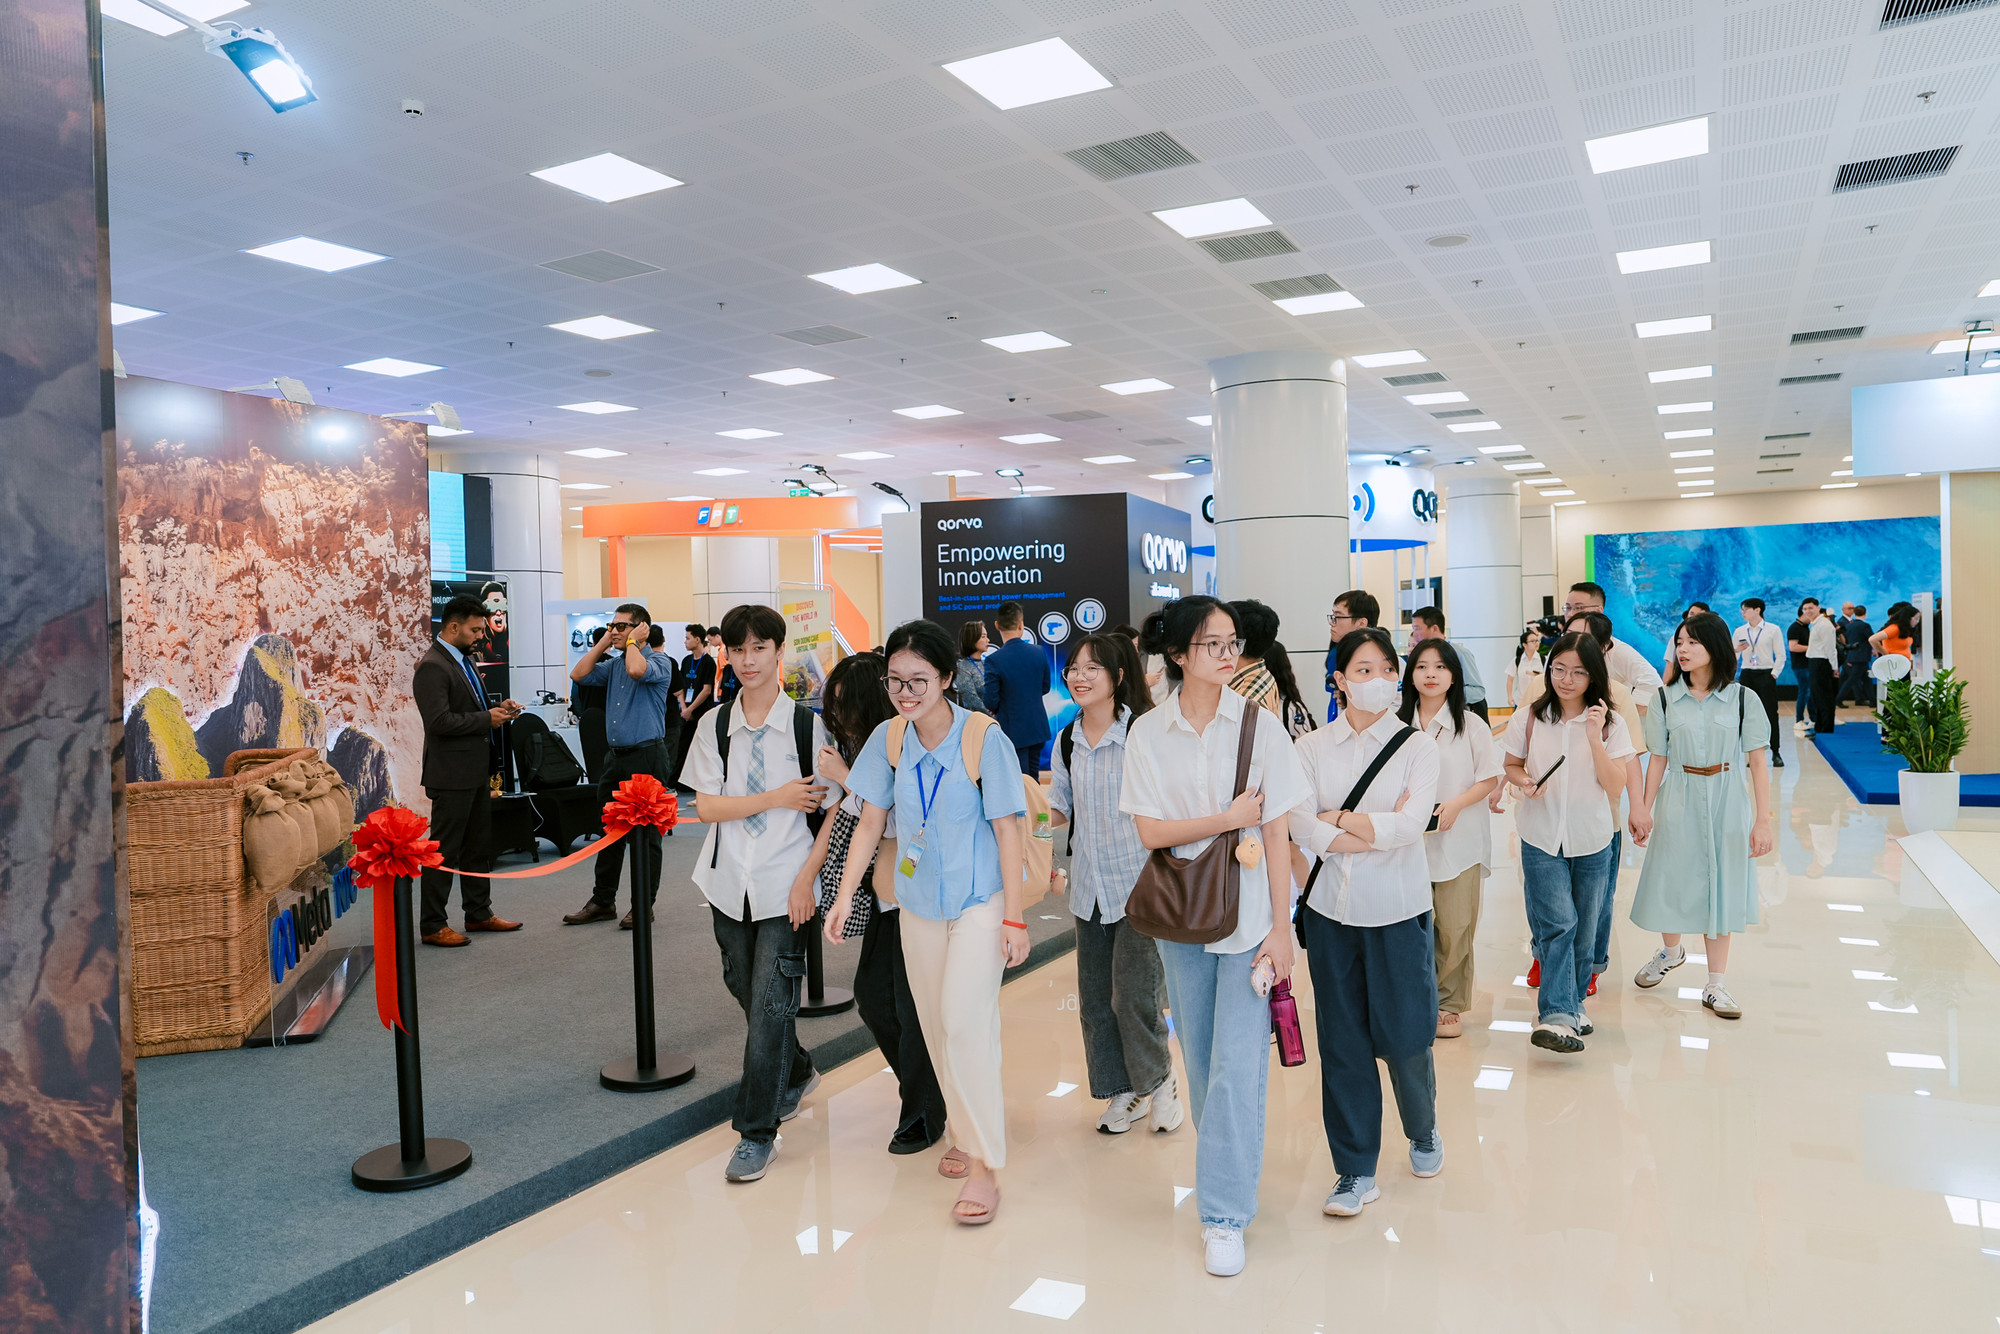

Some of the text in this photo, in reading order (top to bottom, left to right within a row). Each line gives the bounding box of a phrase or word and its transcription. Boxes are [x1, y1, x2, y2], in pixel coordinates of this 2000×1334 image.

[937, 539, 1066, 566] Empowering
[938, 564, 1042, 587] Innovation
[938, 592, 1066, 602] Best-in-class smart power management
[952, 603, 963, 611] SiC
[964, 603, 983, 611] power
[985, 602, 1002, 611] prod
[290, 885, 332, 963] Meta
